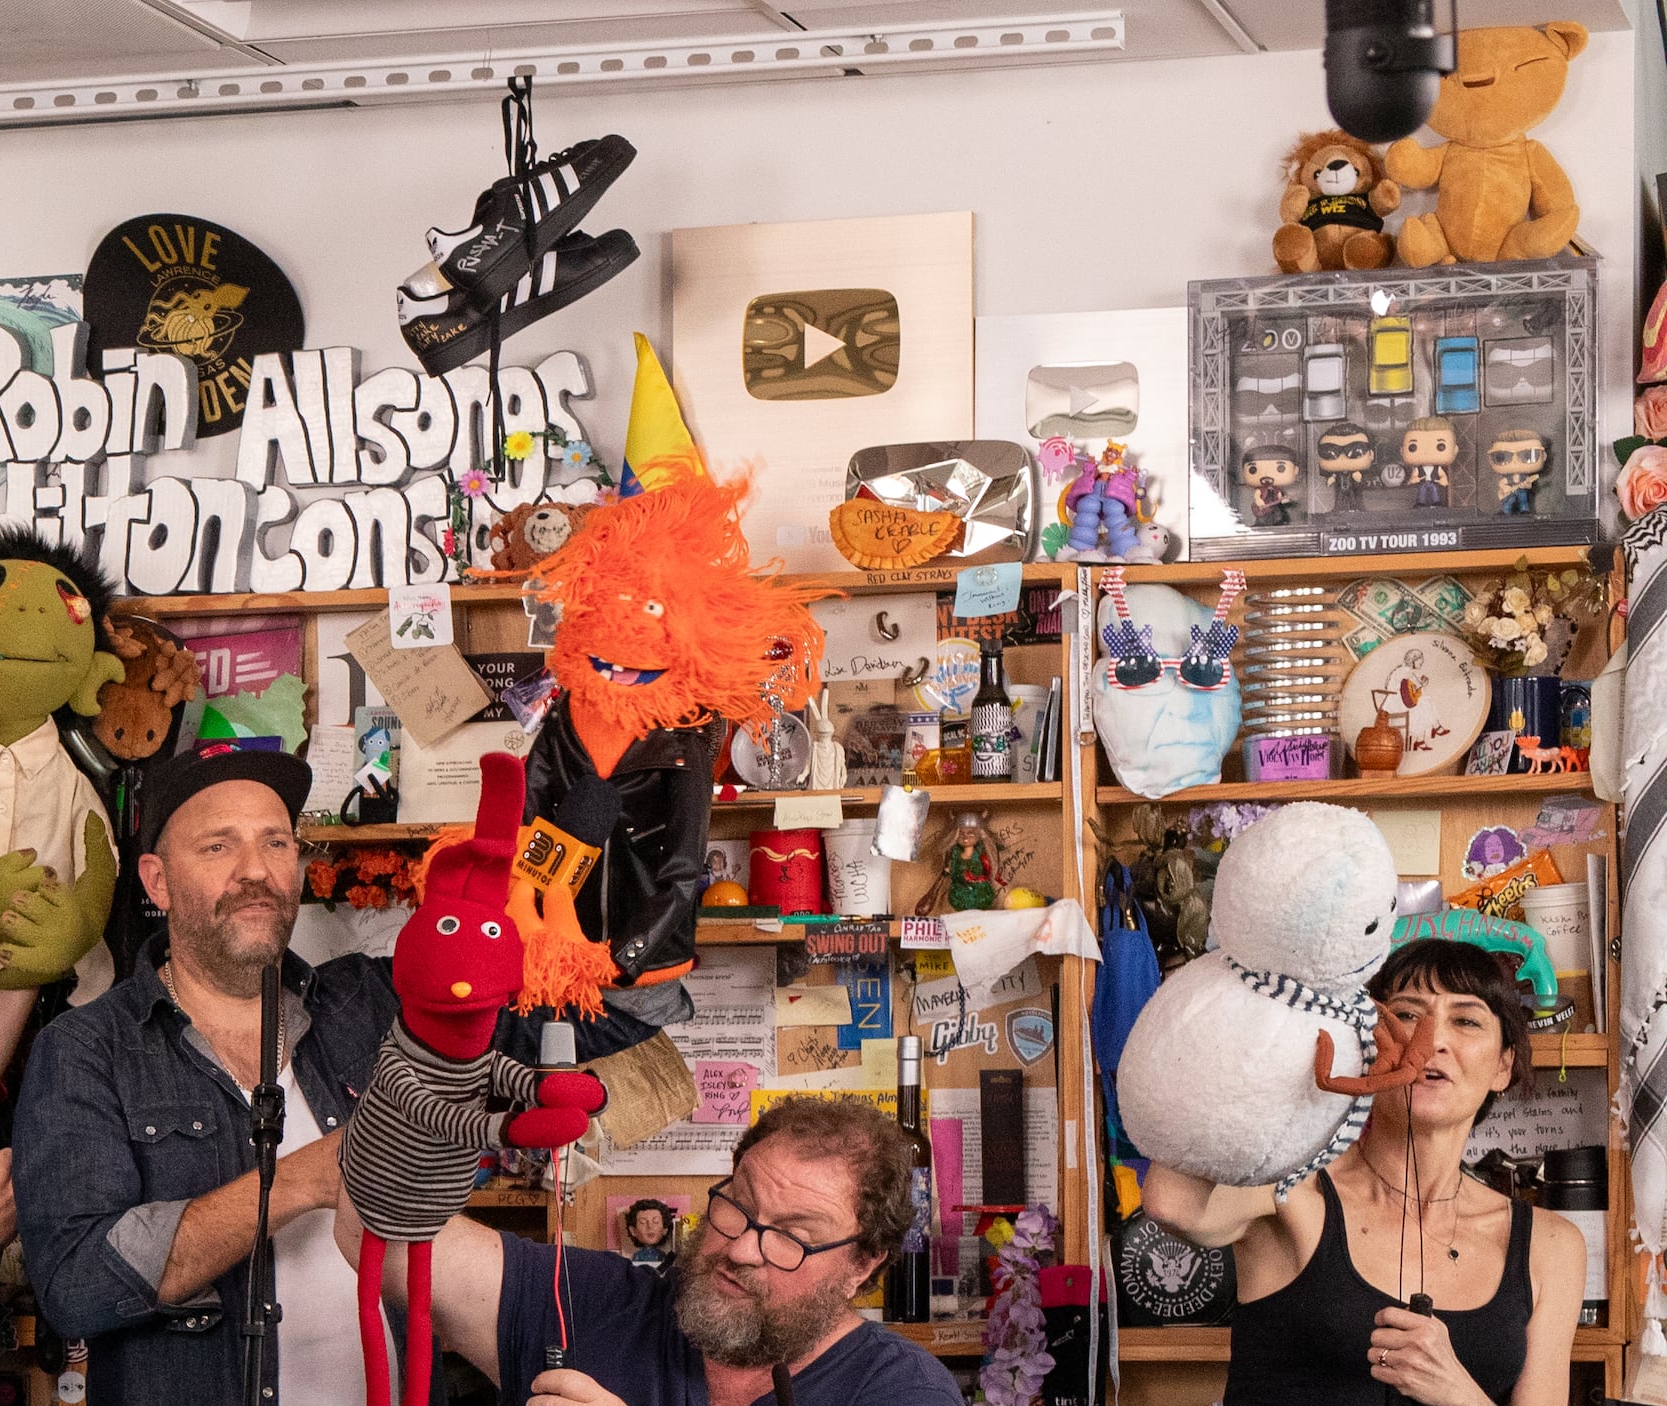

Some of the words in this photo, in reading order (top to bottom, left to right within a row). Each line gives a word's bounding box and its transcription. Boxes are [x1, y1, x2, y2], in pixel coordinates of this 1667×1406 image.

[122, 225, 221, 272] LOVE
[151, 267, 221, 288] LAWRENCE
[1387, 465, 1404, 480] U2
[856, 508, 907, 527] SASHA
[1329, 536, 1357, 552] ZOO
[1359, 535, 1376, 551] TV
[1378, 533, 1418, 549] TOUR
[1422, 531, 1457, 548] 1993
[865, 573, 886, 585] RED
[478, 662, 516, 675] YOUR
[483, 707, 504, 720] MY
[523, 830, 566, 878] 31
[516, 860, 554, 887] MINUTOS
[903, 922, 940, 936] PHIL
[807, 936, 855, 954] SWING
[858, 933, 888, 953] OUT
[903, 935, 943, 944] HARMONIC
[919, 961, 950, 972] MIKE
[702, 1069, 724, 1080] ALEX
[704, 1090, 726, 1101] RING
[1120, 1242, 1148, 1306] TOMMY
[1152, 1288, 1213, 1317] DEEDEE
